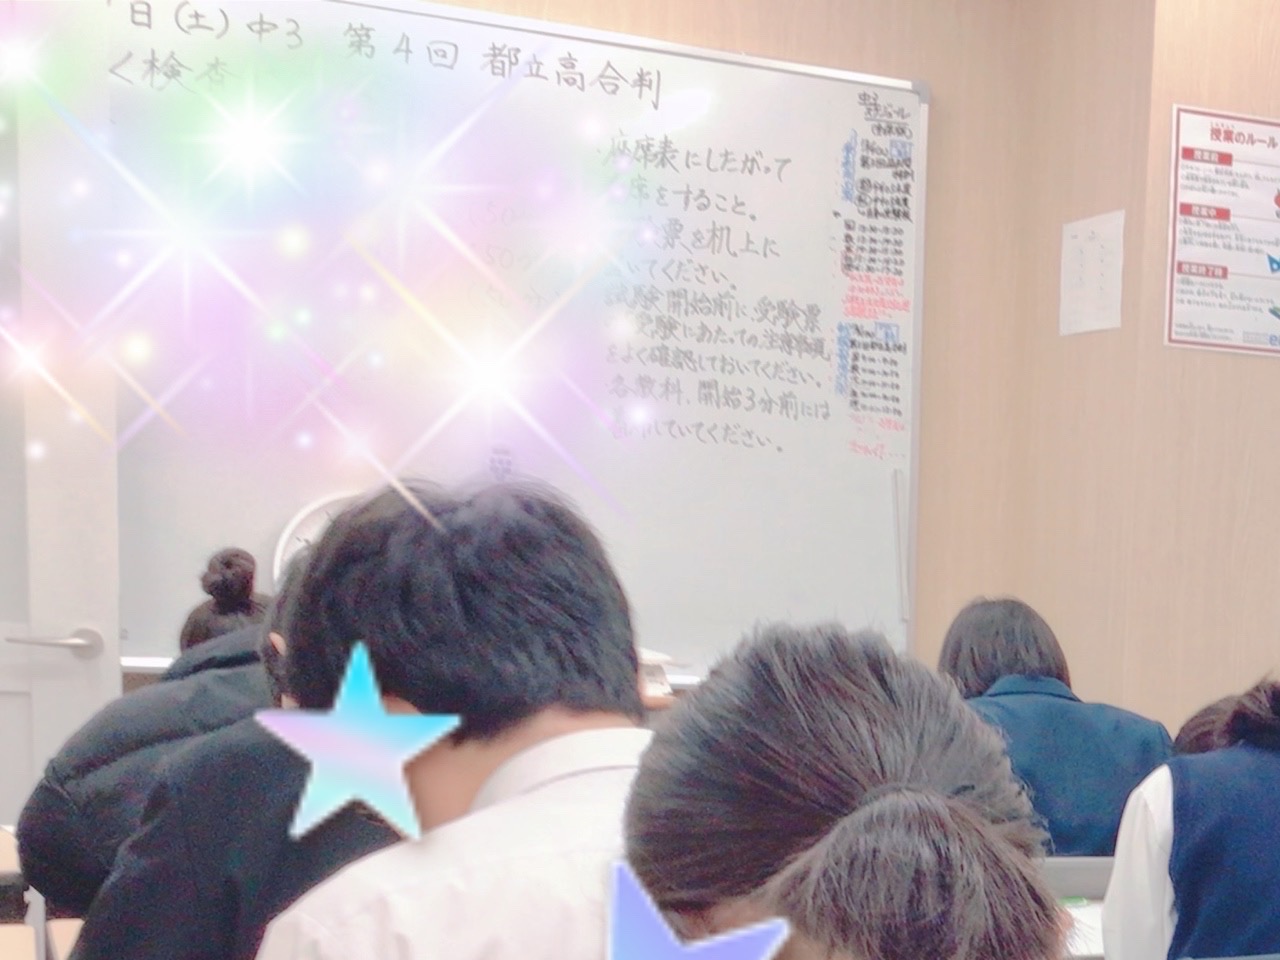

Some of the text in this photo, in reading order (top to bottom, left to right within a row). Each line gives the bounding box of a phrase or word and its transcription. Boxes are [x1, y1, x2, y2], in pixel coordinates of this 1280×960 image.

[343, 22, 459, 70] 第4回
[1210, 127, 1279, 149] 授業のルール
[628, 172, 758, 222] 席をすること。
[637, 215, 782, 260] 票を机上に
[625, 256, 738, 291] いてください。
